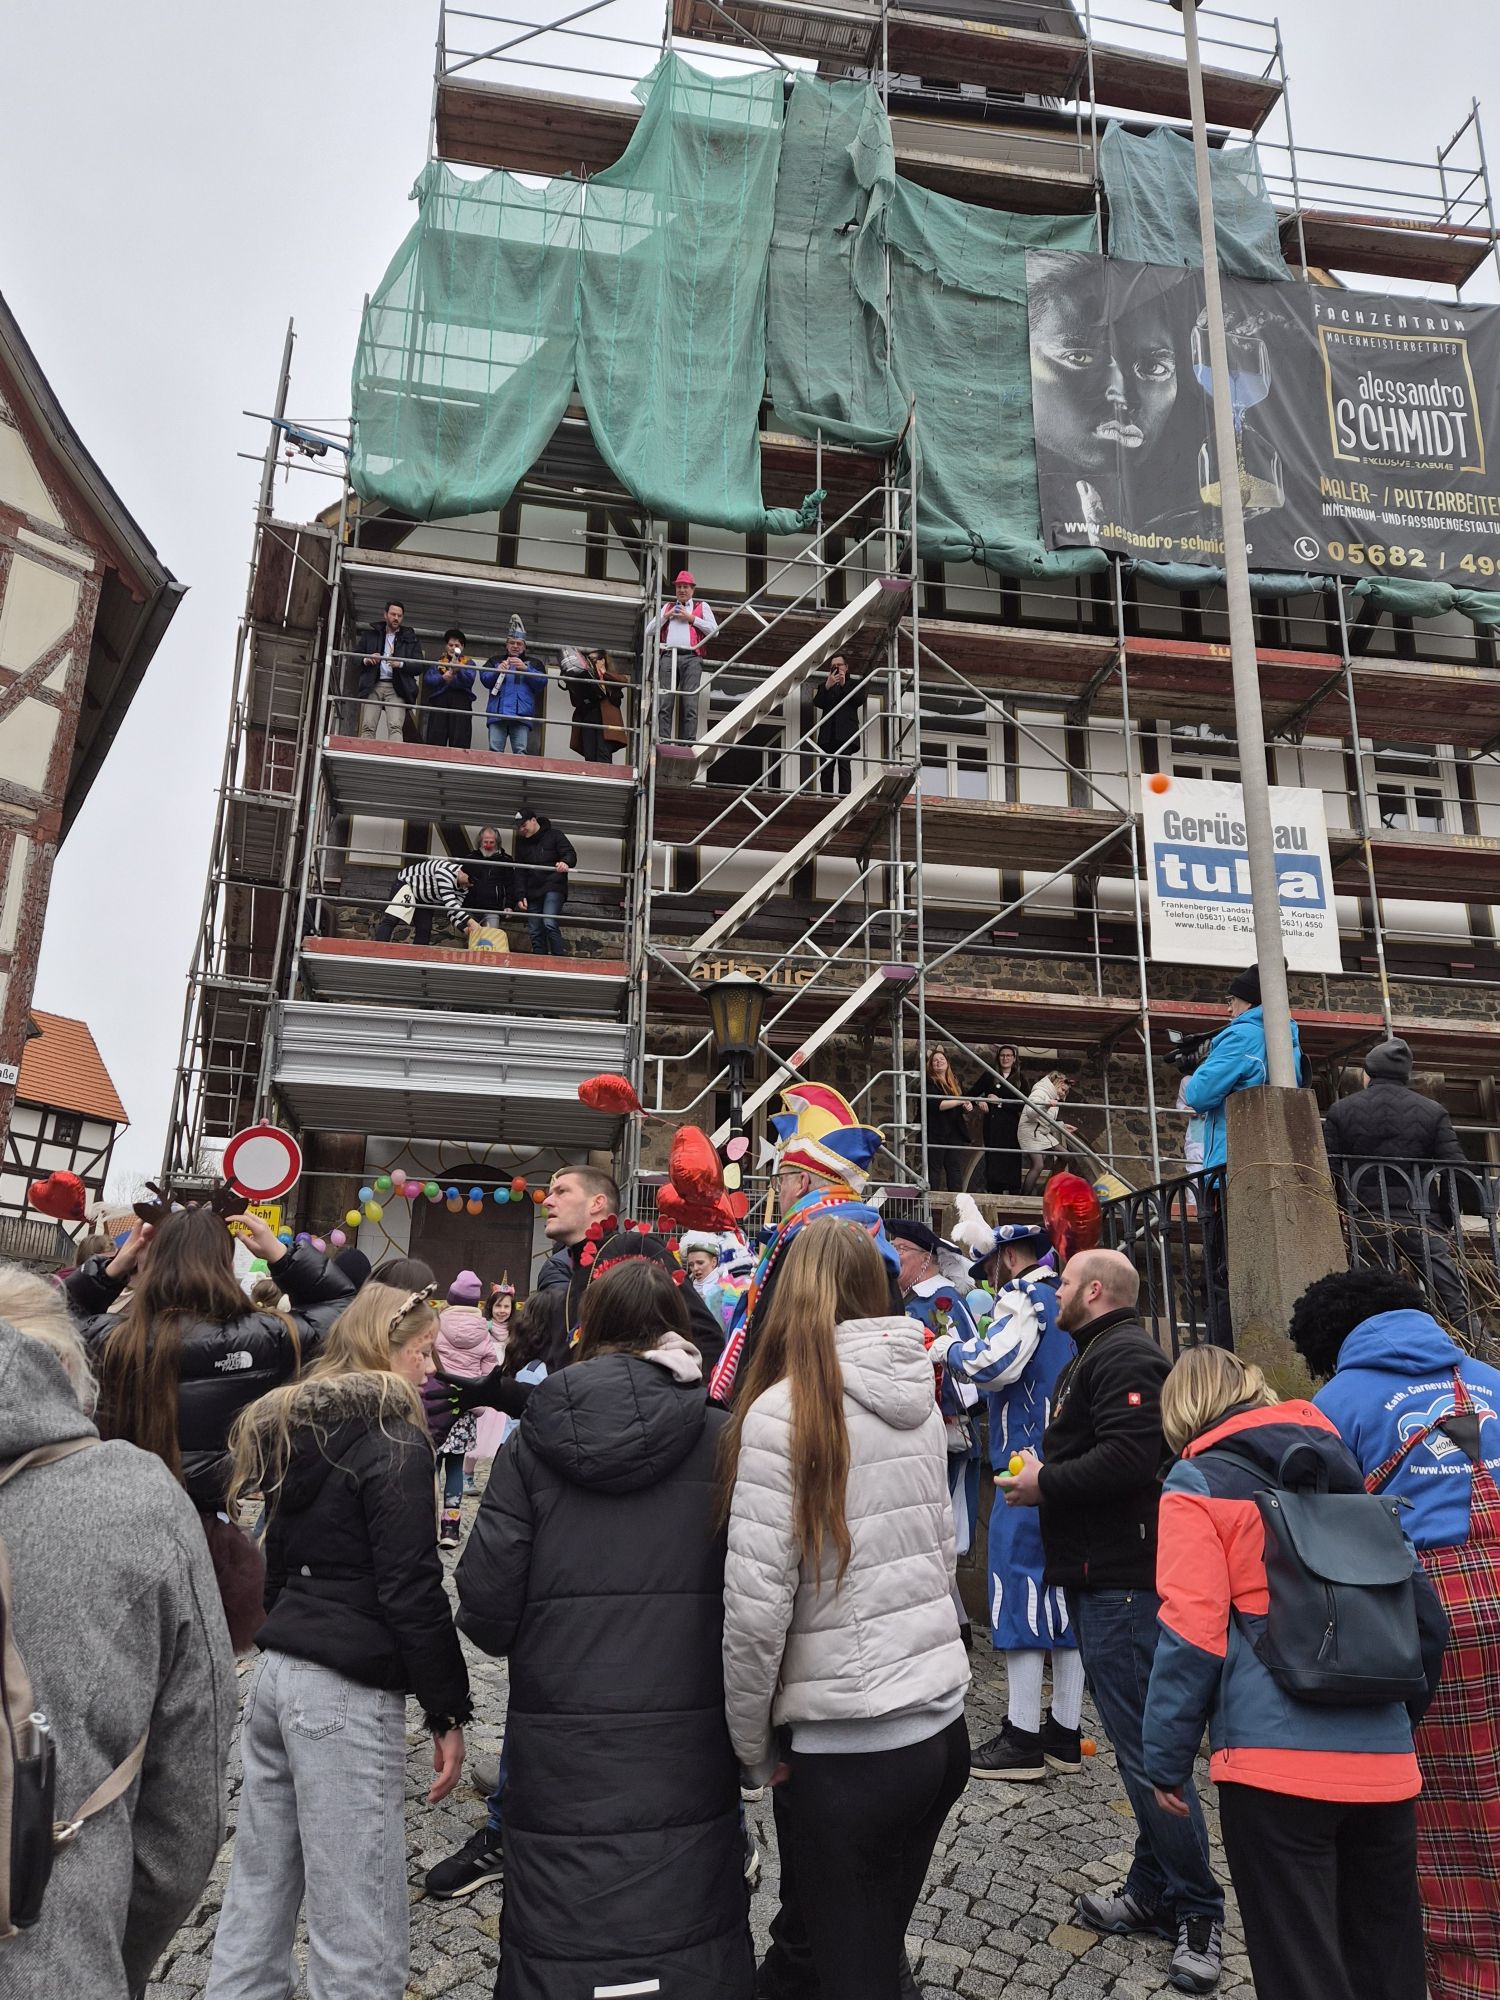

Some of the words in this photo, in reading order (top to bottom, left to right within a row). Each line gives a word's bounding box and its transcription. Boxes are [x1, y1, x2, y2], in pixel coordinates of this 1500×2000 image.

[1314, 303, 1465, 332] FACHZENTRUM
[1326, 332, 1457, 355] MALERMEISTERBETRIEB
[1357, 370, 1465, 408] alessandro
[1336, 398, 1468, 458] SCHMIDT
[1319, 475, 1378, 504] MALER-
[1394, 488, 1500, 516] PUTZARBEITE
[1328, 541, 1427, 568] 05682
[1460, 553, 1500, 576] 49
[1163, 809, 1308, 851] Gerüsau
[1160, 853, 1321, 900] tula
[1161, 901, 1219, 914] Frankenberger
[1222, 905, 1255, 915] Landstr
[1291, 910, 1325, 920] Korbach
[1165, 910, 1195, 919] Telefon
[1196, 913, 1226, 923] (05631)
[1227, 915, 1250, 924] 64091
[1281, 919, 1303, 928] 5631)
[1304, 921, 1323, 929] 4550
[1174, 921, 1226, 931] www.tulla.de
[225, 1352, 241, 1360] THE
[1384, 1392, 1409, 1411] Kath.
